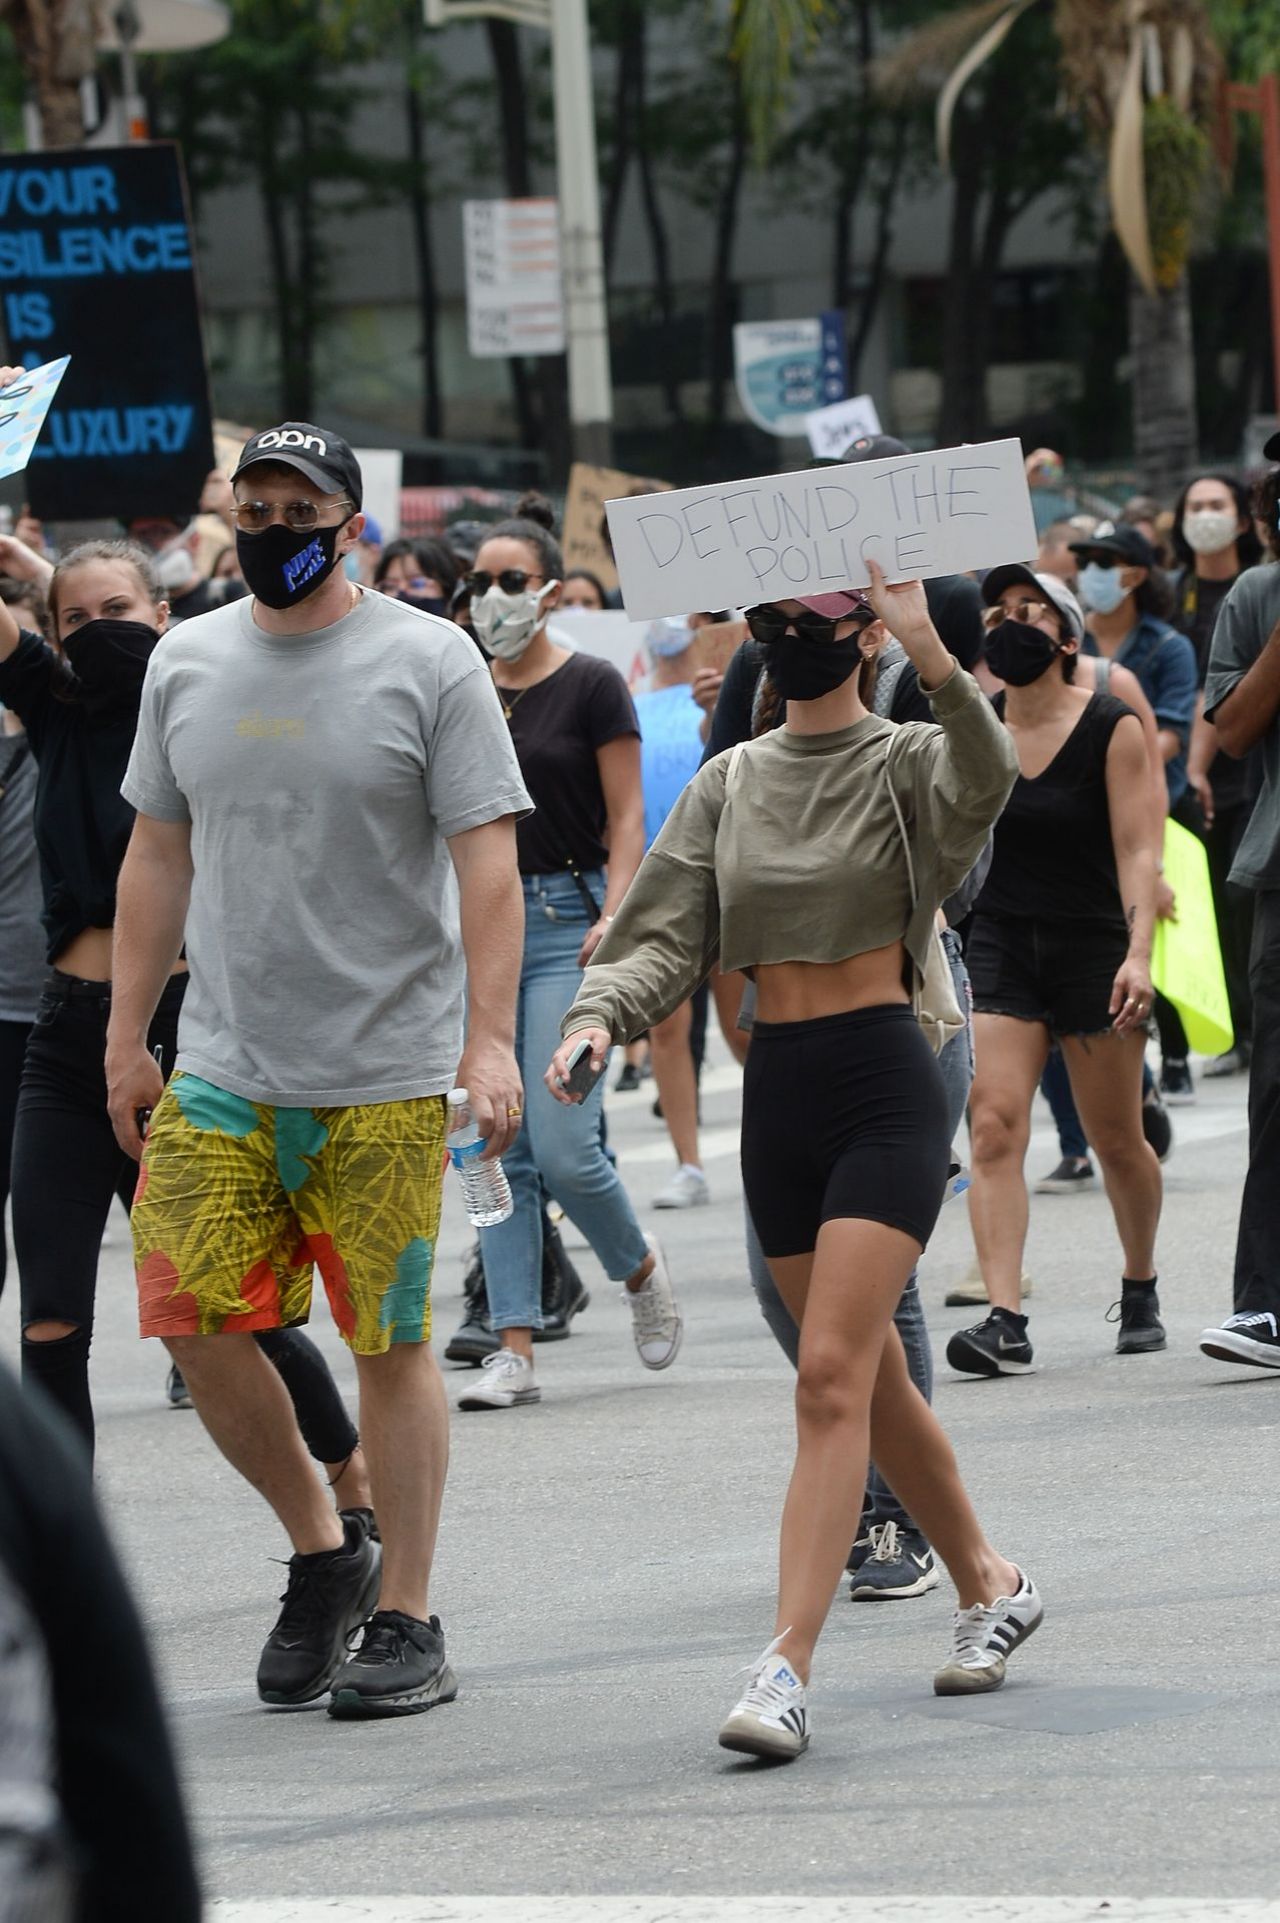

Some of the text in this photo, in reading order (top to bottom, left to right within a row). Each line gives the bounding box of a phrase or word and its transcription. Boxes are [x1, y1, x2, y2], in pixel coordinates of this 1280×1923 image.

[0, 223, 192, 278] SILENCE
[6, 291, 55, 341] IS
[257, 429, 326, 457] opn
[636, 485, 859, 568] DEFUND
[873, 464, 1001, 525] THE
